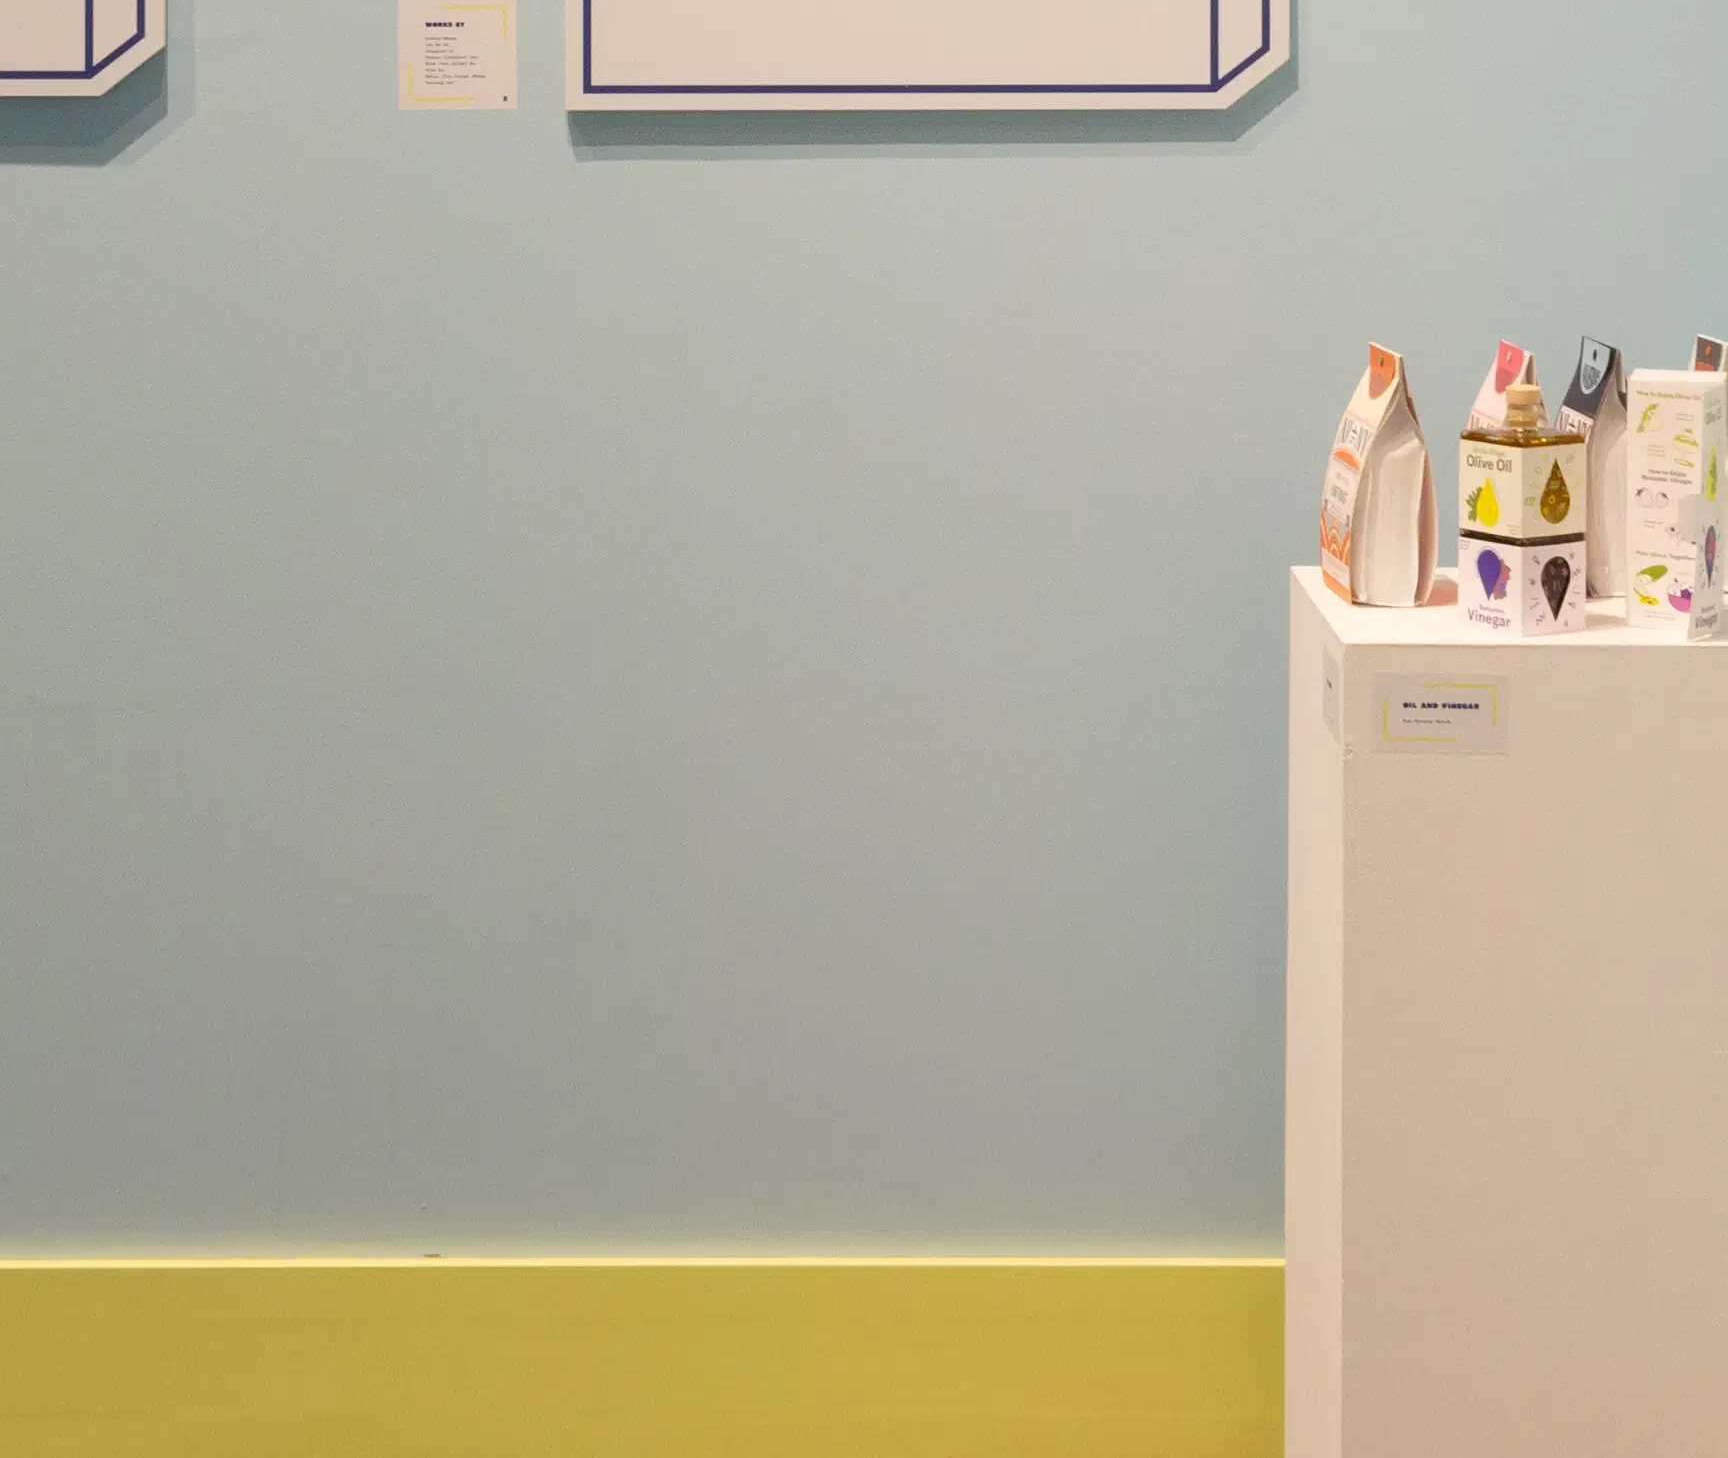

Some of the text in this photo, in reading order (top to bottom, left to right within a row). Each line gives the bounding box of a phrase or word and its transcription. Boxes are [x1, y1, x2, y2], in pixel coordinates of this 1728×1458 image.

[1466, 453, 1513, 473] Olive Oil
[1467, 606, 1512, 630] Vinegar
[1420, 701, 1439, 709] AND
[1442, 702, 1480, 710] VINEGAR
